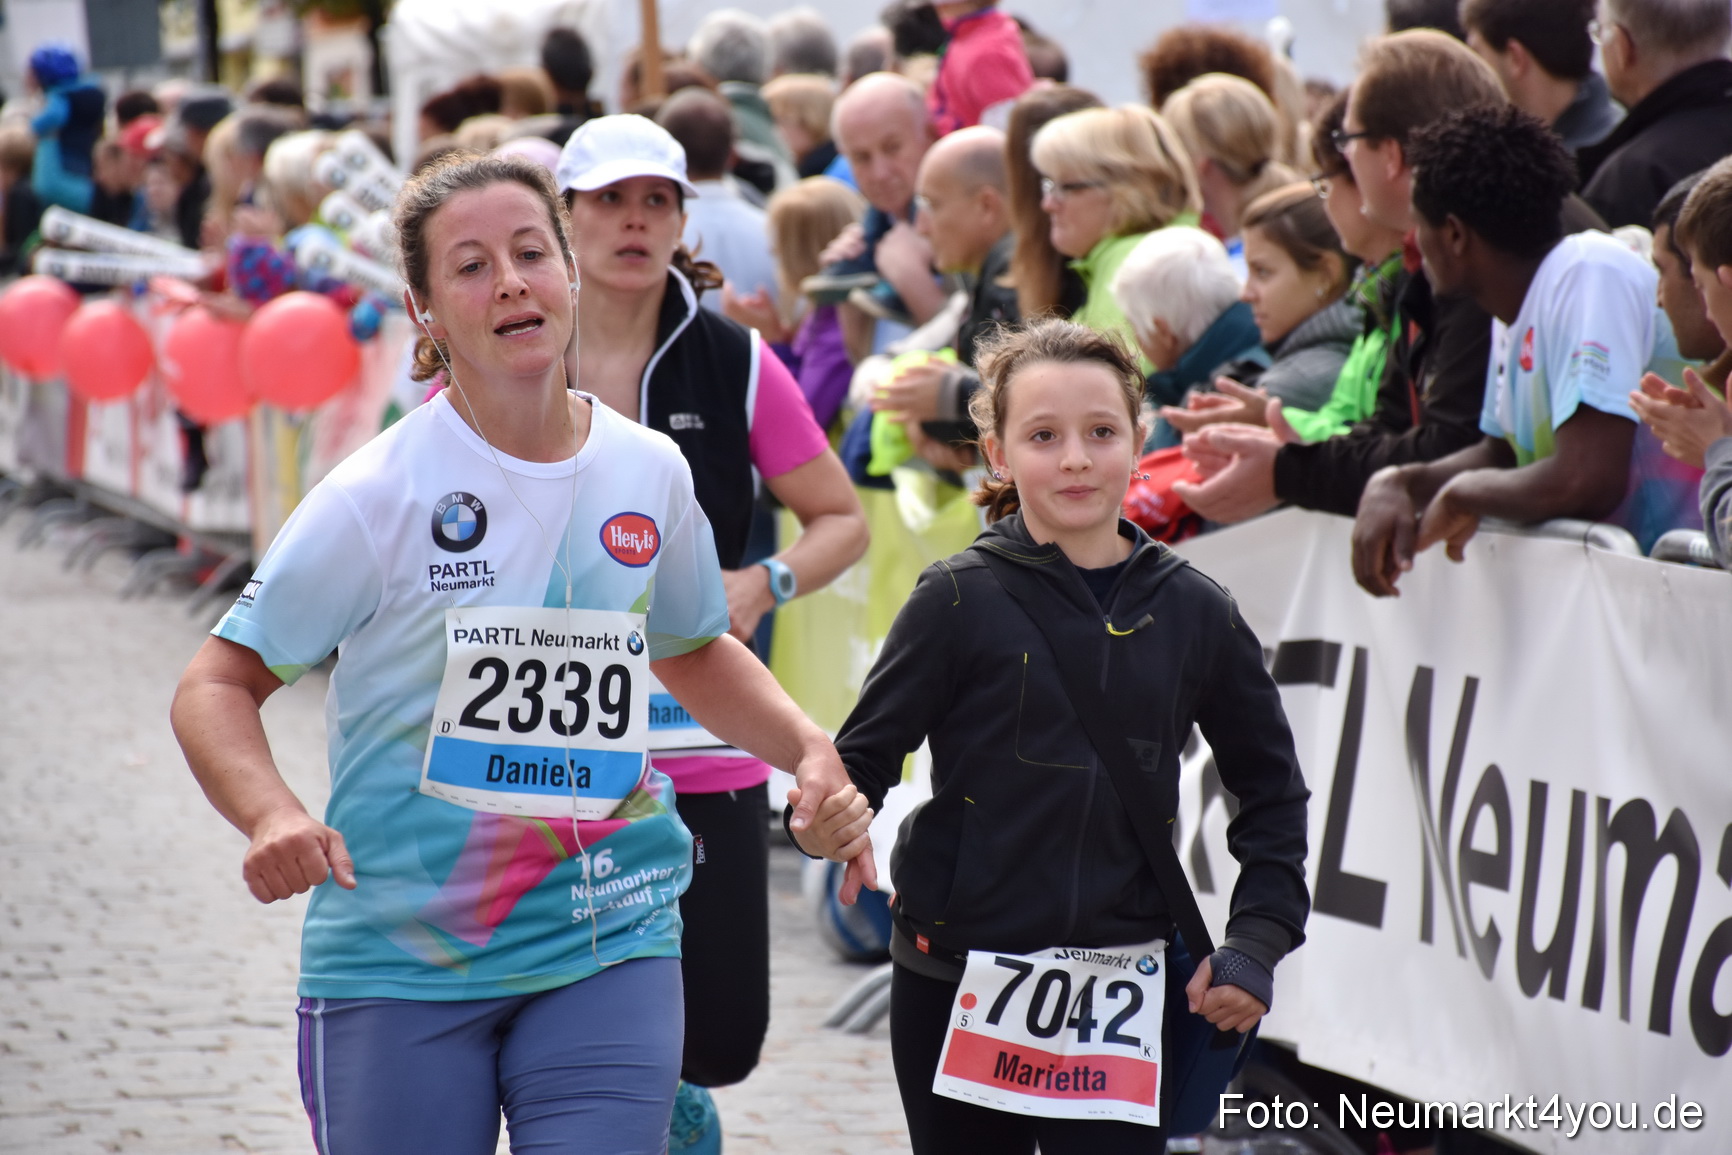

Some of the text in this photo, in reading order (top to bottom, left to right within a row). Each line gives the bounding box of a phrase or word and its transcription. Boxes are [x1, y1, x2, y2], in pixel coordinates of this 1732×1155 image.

[435, 493, 483, 515] BMW
[610, 525, 655, 553] Hervis
[428, 560, 495, 580] PARTL
[430, 576, 495, 592] Neumarkt
[453, 627, 525, 646] PARTL
[530, 628, 620, 651] Neumarkt
[458, 656, 632, 740] 2339
[485, 754, 591, 789] Daniela
[575, 848, 622, 880] 16.
[571, 867, 674, 901] Neumarkter
[985, 955, 1144, 1048] 7042
[993, 1050, 1107, 1092] Marietta
